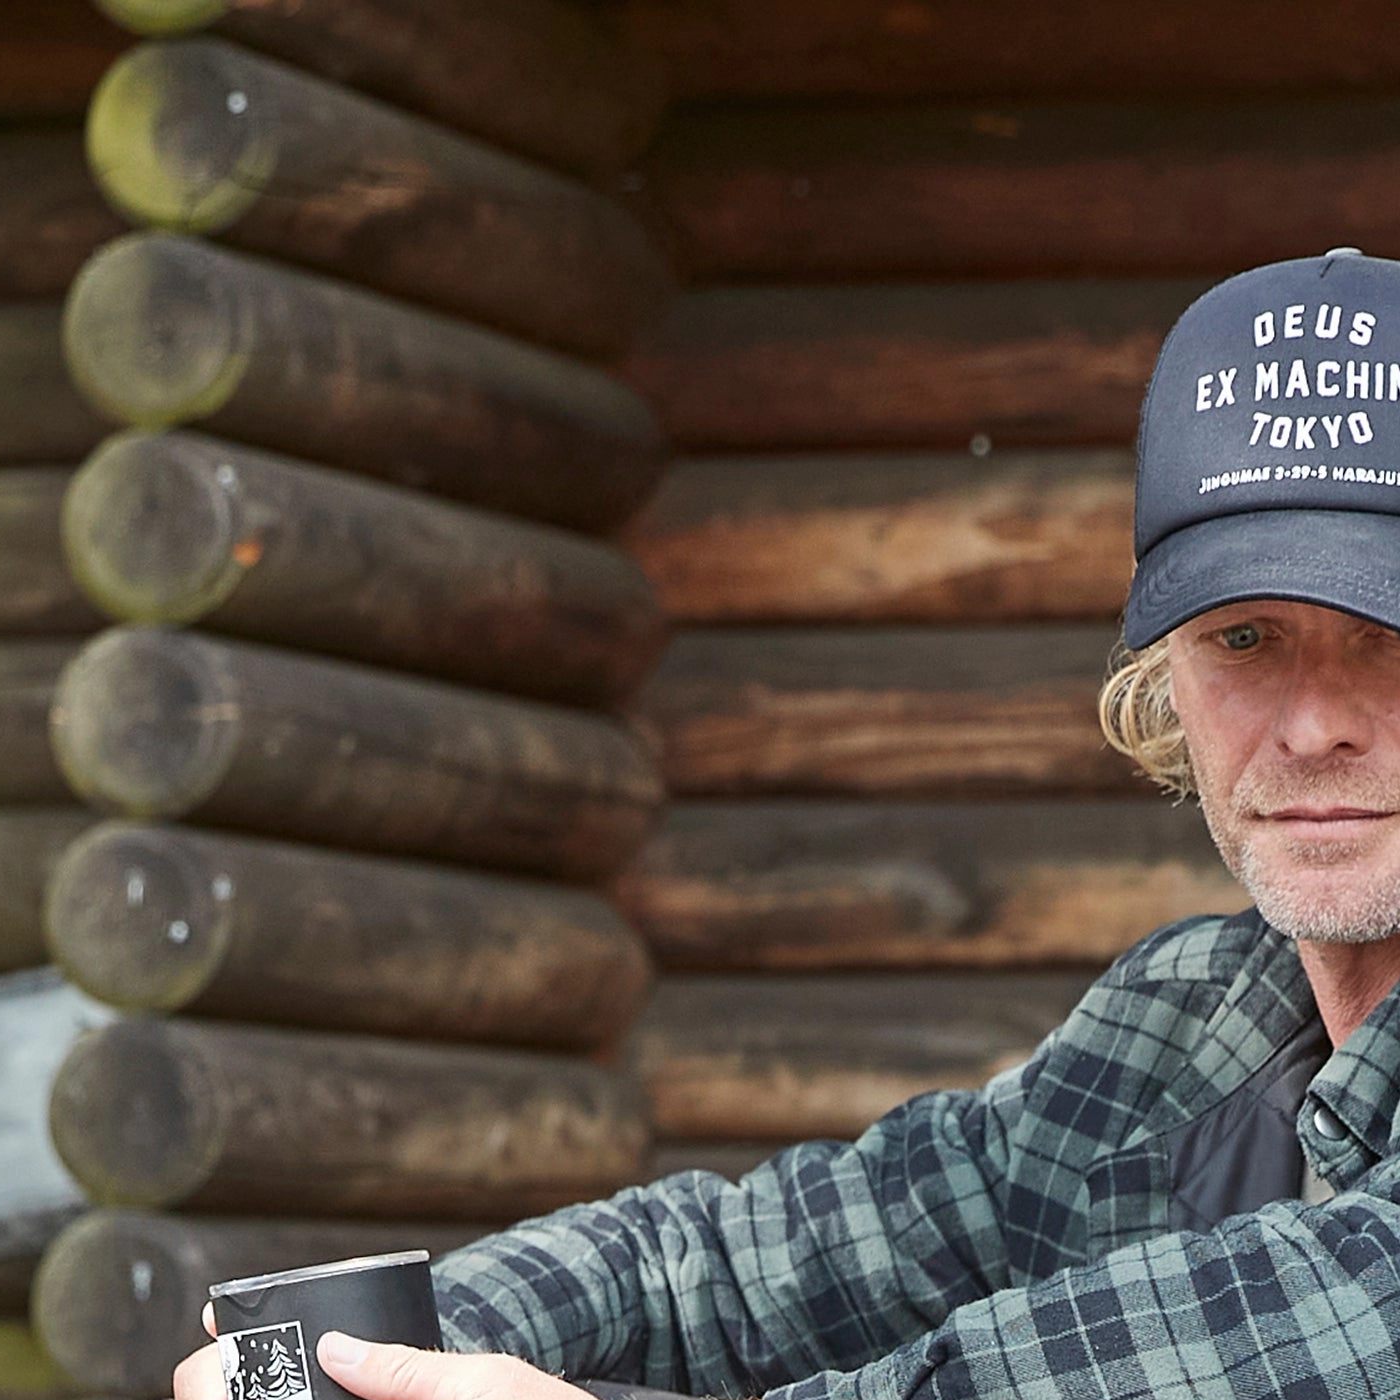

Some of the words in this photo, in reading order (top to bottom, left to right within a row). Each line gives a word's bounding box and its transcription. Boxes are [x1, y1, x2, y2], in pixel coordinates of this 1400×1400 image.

[1253, 303, 1377, 348] DEUS
[1195, 367, 1238, 412] EX
[1248, 411, 1374, 450] TOKYO
